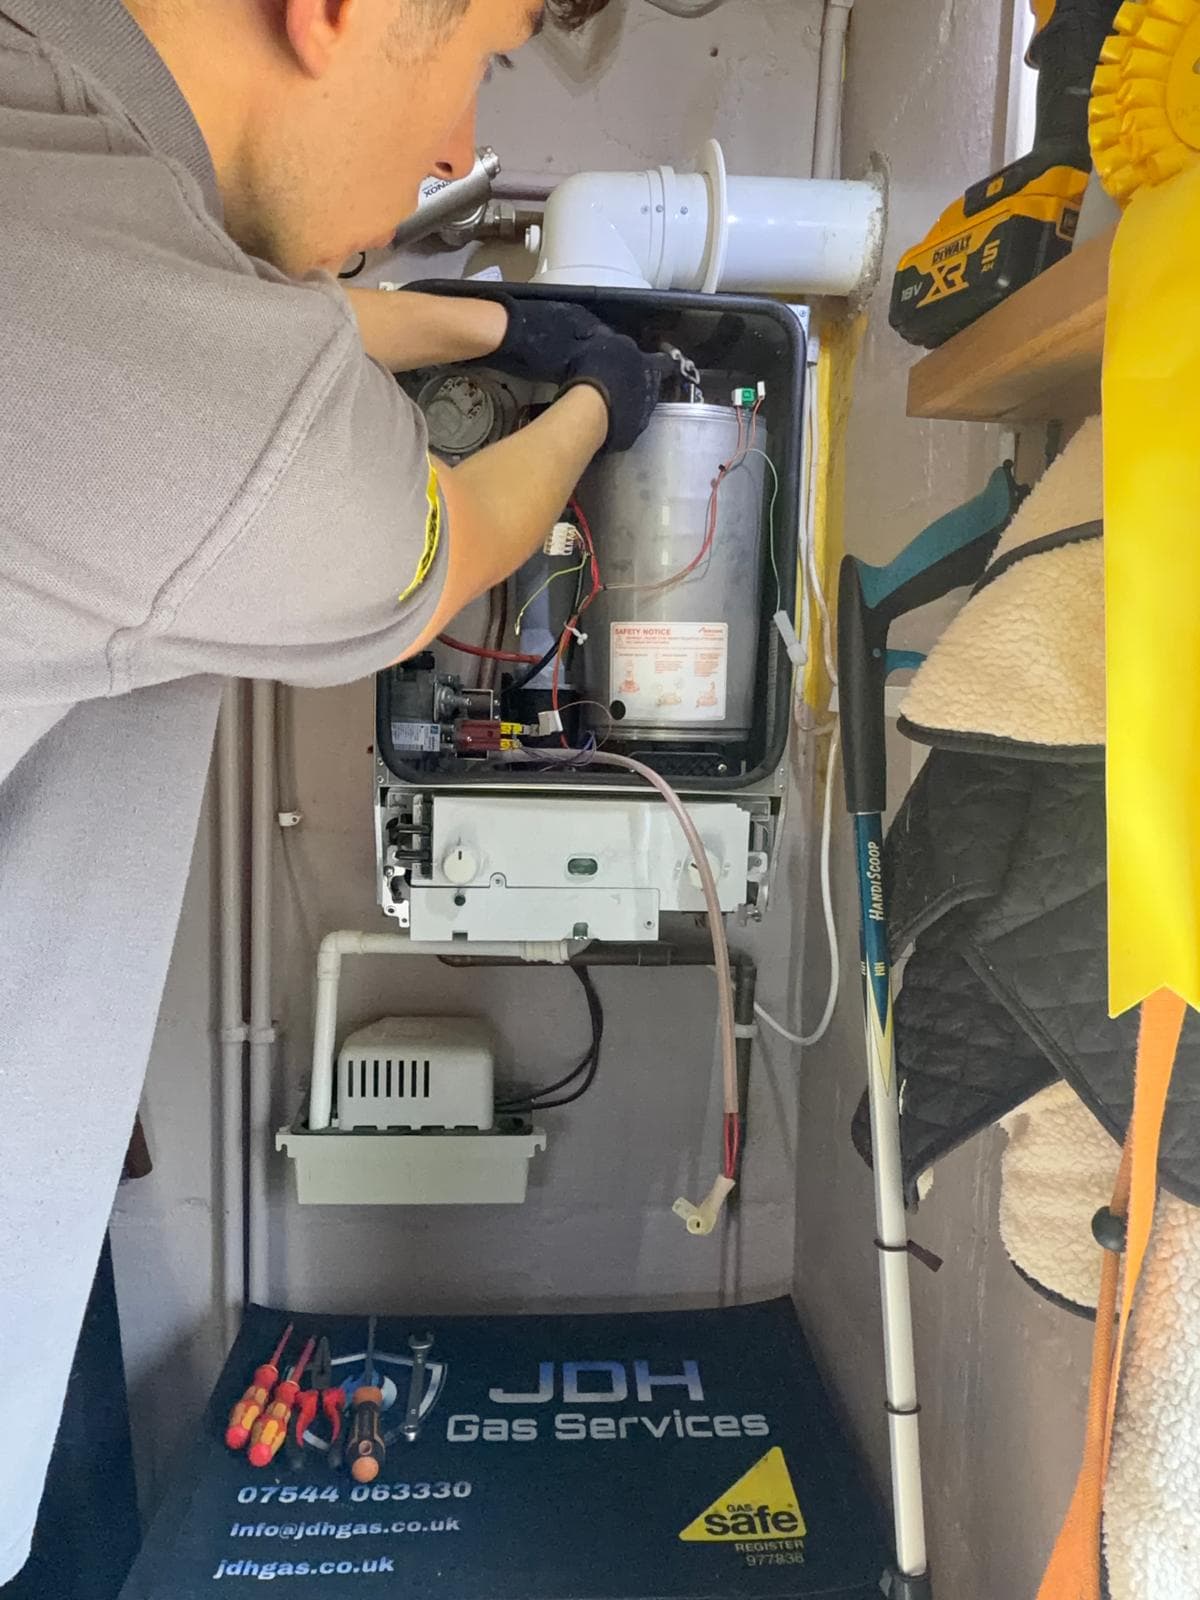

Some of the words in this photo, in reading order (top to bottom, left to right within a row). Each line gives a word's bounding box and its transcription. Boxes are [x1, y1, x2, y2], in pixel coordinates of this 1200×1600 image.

[900, 280, 924, 303] 18V
[615, 628, 641, 636] SAFETY
[642, 628, 672, 636] NOTICE
[488, 1359, 706, 1405] JDH
[446, 1414, 538, 1443] Gas
[554, 1408, 770, 1441] Services
[236, 1484, 340, 1505] 07544
[350, 1480, 473, 1503] 063330
[704, 1504, 799, 1536] safe
[726, 1503, 753, 1512] GAS
[735, 1540, 804, 1553] REGISTER
[212, 1556, 395, 1581] jdhgas.co.uk
